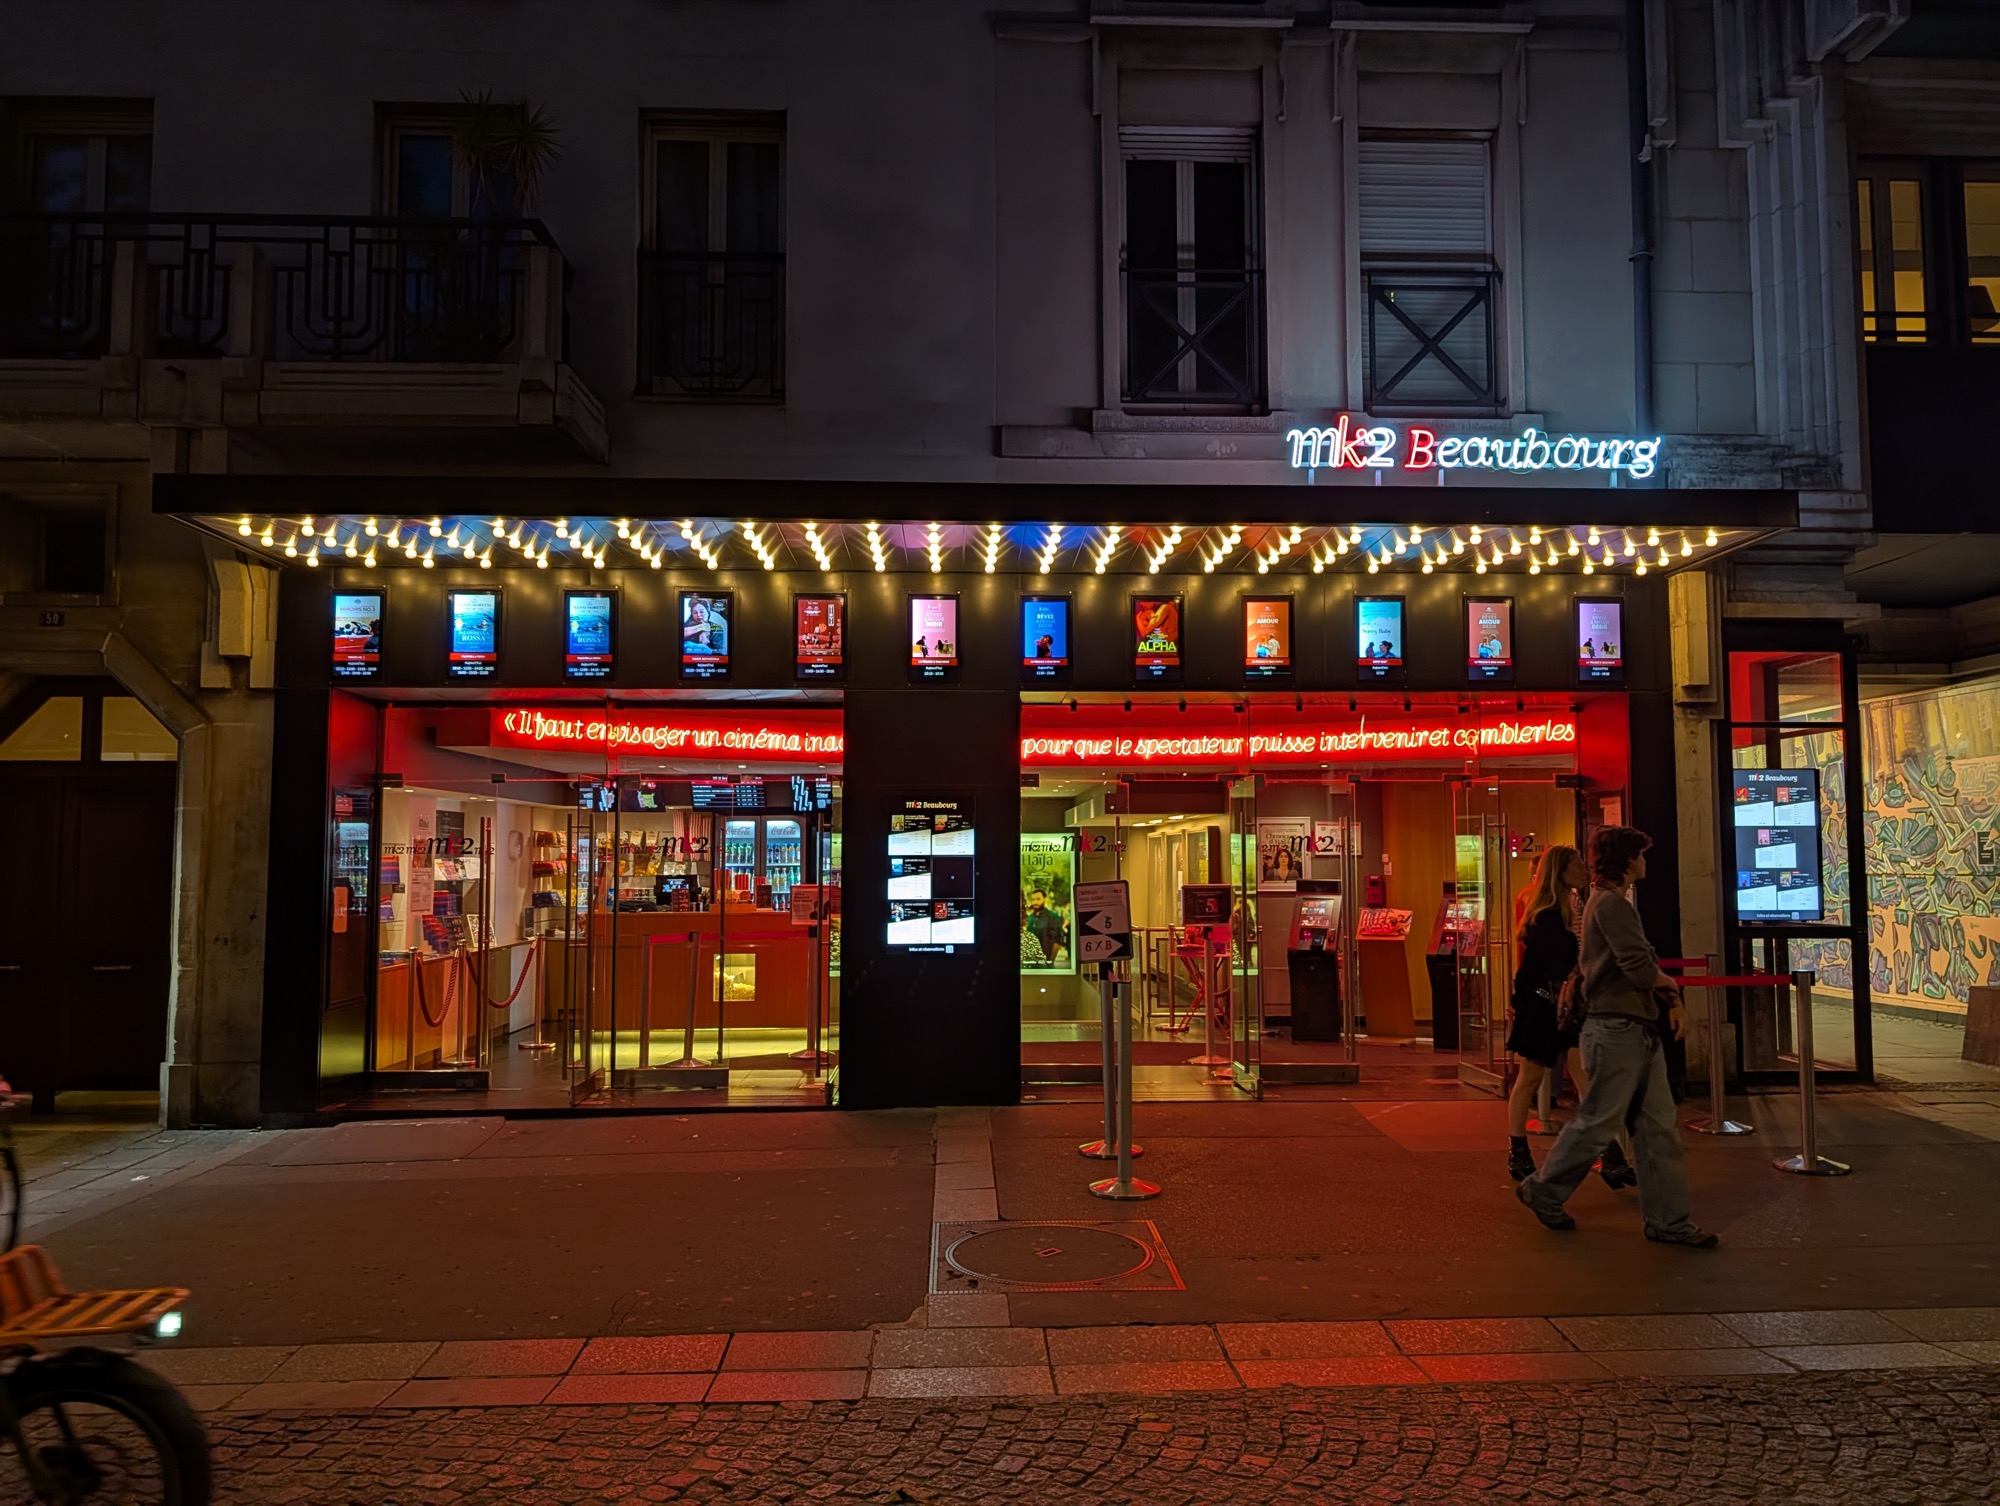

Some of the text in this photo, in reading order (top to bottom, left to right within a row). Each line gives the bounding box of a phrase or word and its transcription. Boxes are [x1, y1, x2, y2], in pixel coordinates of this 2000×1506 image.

[1287, 415, 1661, 478] mk2 Beaubourg
[1138, 642, 1176, 652] ALPHA
[533, 712, 584, 741] faut
[586, 720, 691, 750] envisager
[694, 728, 720, 747] un
[722, 727, 801, 752] cinéma
[1022, 719, 1576, 759] pour que le spectateur puisse intervenir et combler les
[1748, 773, 1798, 783] mk2 Beaubourg
[906, 800, 958, 810] mk2 Beaubourg
[384, 843, 404, 854] mk2
[427, 832, 474, 855] mk2
[662, 830, 709, 854] mk2
[1061, 830, 1106, 852] mk2
[1288, 830, 1334, 852] mk2
[1104, 916, 1112, 928] 5
[1085, 942, 1092, 952] 6
